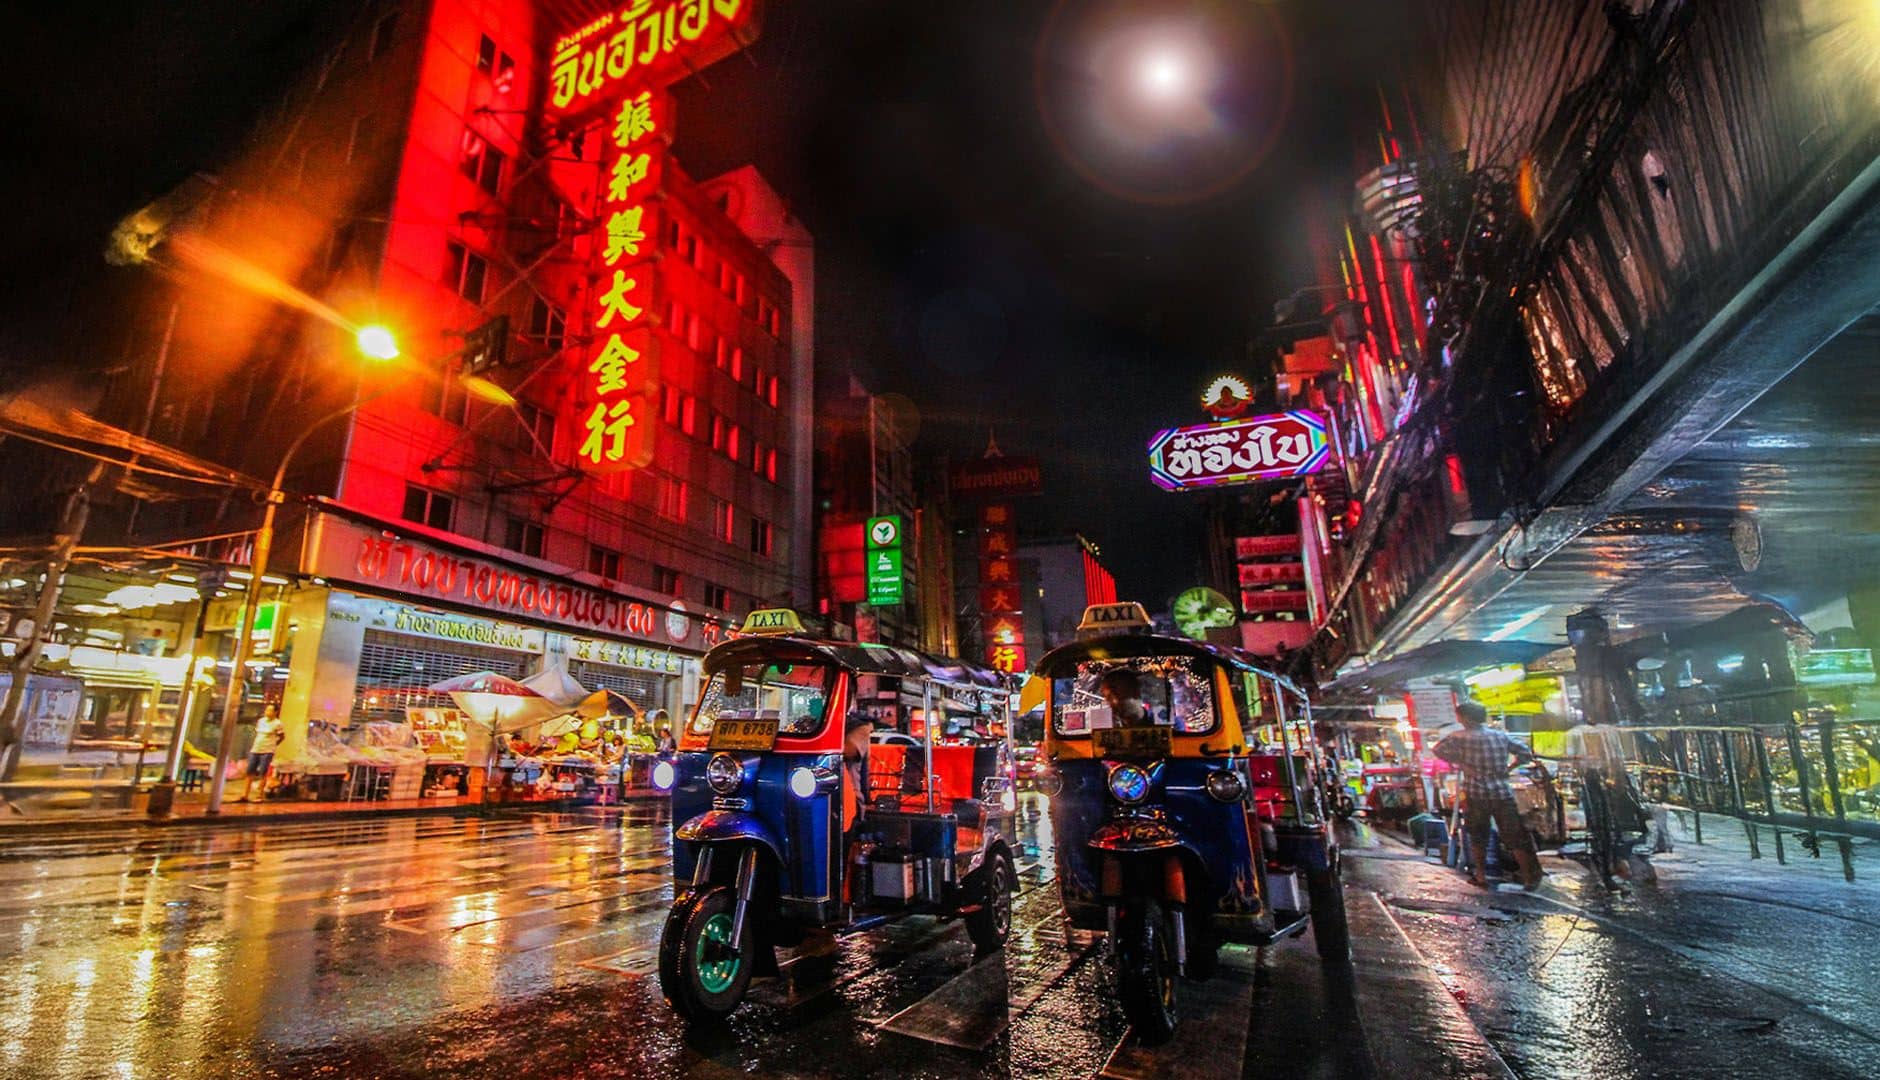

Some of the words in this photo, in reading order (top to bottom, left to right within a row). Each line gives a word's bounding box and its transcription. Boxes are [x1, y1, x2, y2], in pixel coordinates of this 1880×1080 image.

[1168, 425, 1310, 477] ทองใบ
[357, 530, 656, 637] ห้างขายทองจนฮั้วเฮง
[752, 612, 785, 627] TAXI
[1093, 606, 1135, 621] TAXI
[743, 722, 774, 736] 6738
